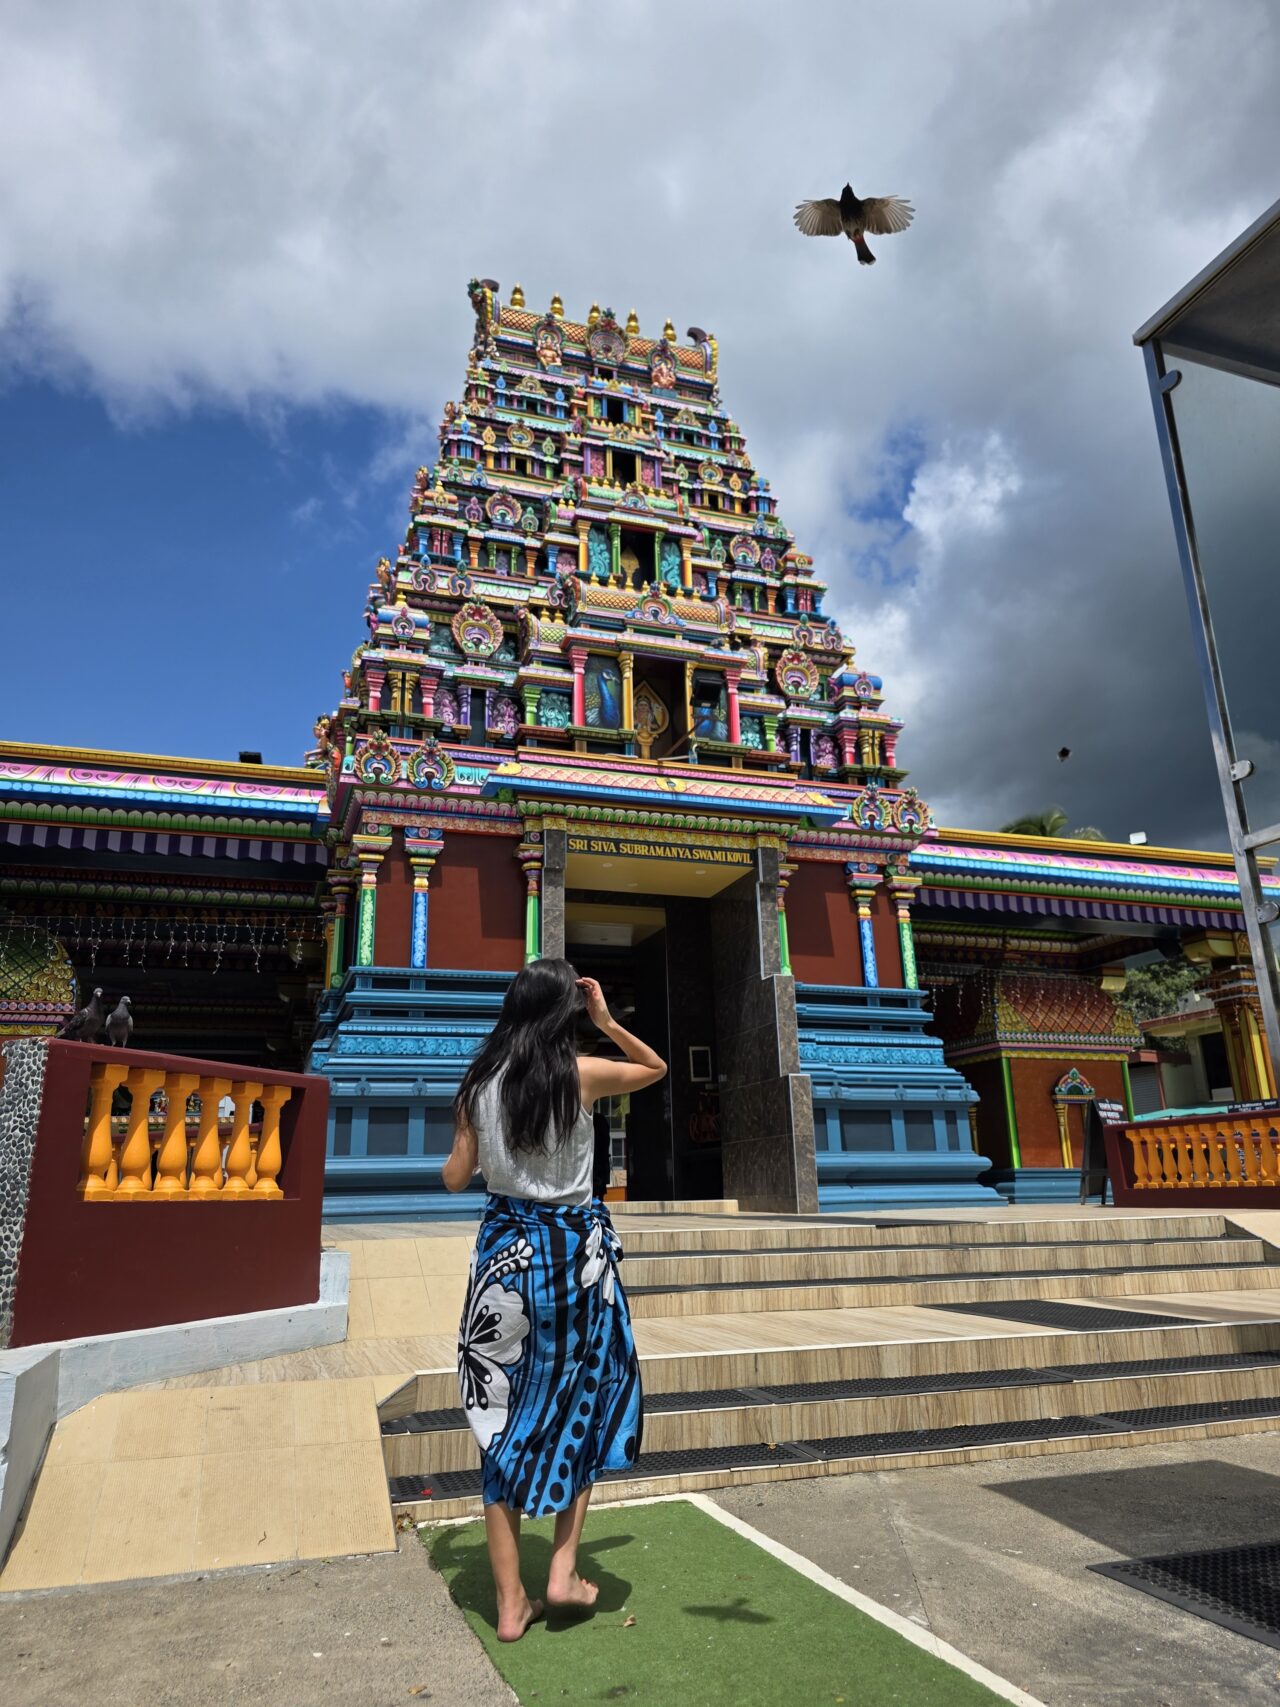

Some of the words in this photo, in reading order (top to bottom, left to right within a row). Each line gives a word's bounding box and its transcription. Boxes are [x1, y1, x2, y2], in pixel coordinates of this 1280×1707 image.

[568, 839, 588, 850] SRI
[591, 841, 616, 853] SIVA
[620, 843, 691, 859] SUBRAMANYA
[693, 849, 725, 862] SWAMI
[727, 852, 752, 864] KOVIL
